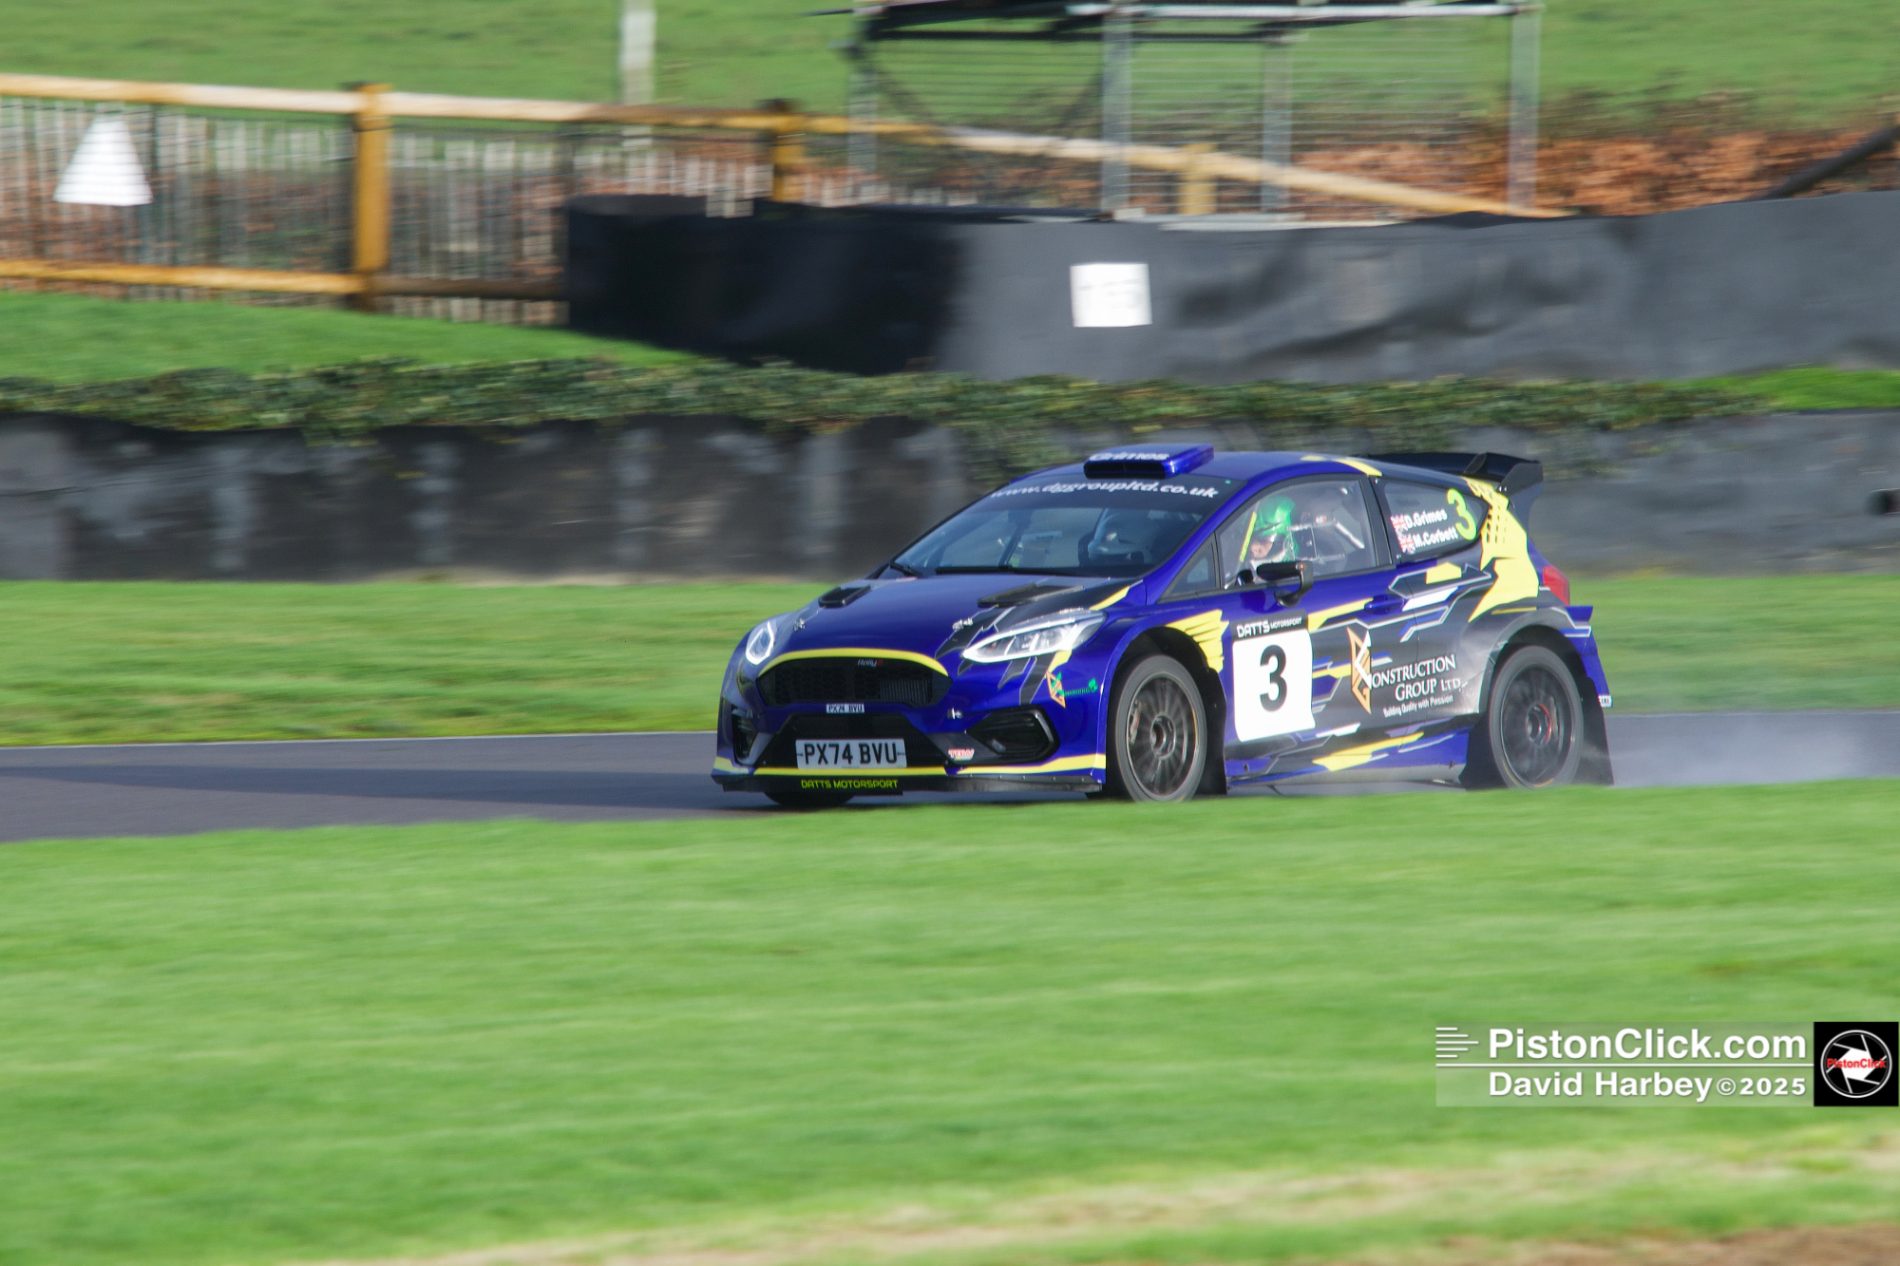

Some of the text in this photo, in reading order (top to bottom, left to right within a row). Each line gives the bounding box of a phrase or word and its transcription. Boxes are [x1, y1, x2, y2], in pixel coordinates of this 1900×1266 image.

[989, 480, 1218, 499] www.dggroupltd.co.uk
[1405, 508, 1448, 529] D.Grimes
[1447, 487, 1477, 541] 3
[1236, 616, 1302, 638] DATTS MOTORSPORT
[1259, 644, 1287, 712] 3
[1395, 679, 1437, 702] GROUP
[1418, 698, 1430, 709] with
[804, 743, 897, 765] PX74 BVU
[801, 779, 898, 789] DATTS MOTORSPORT
